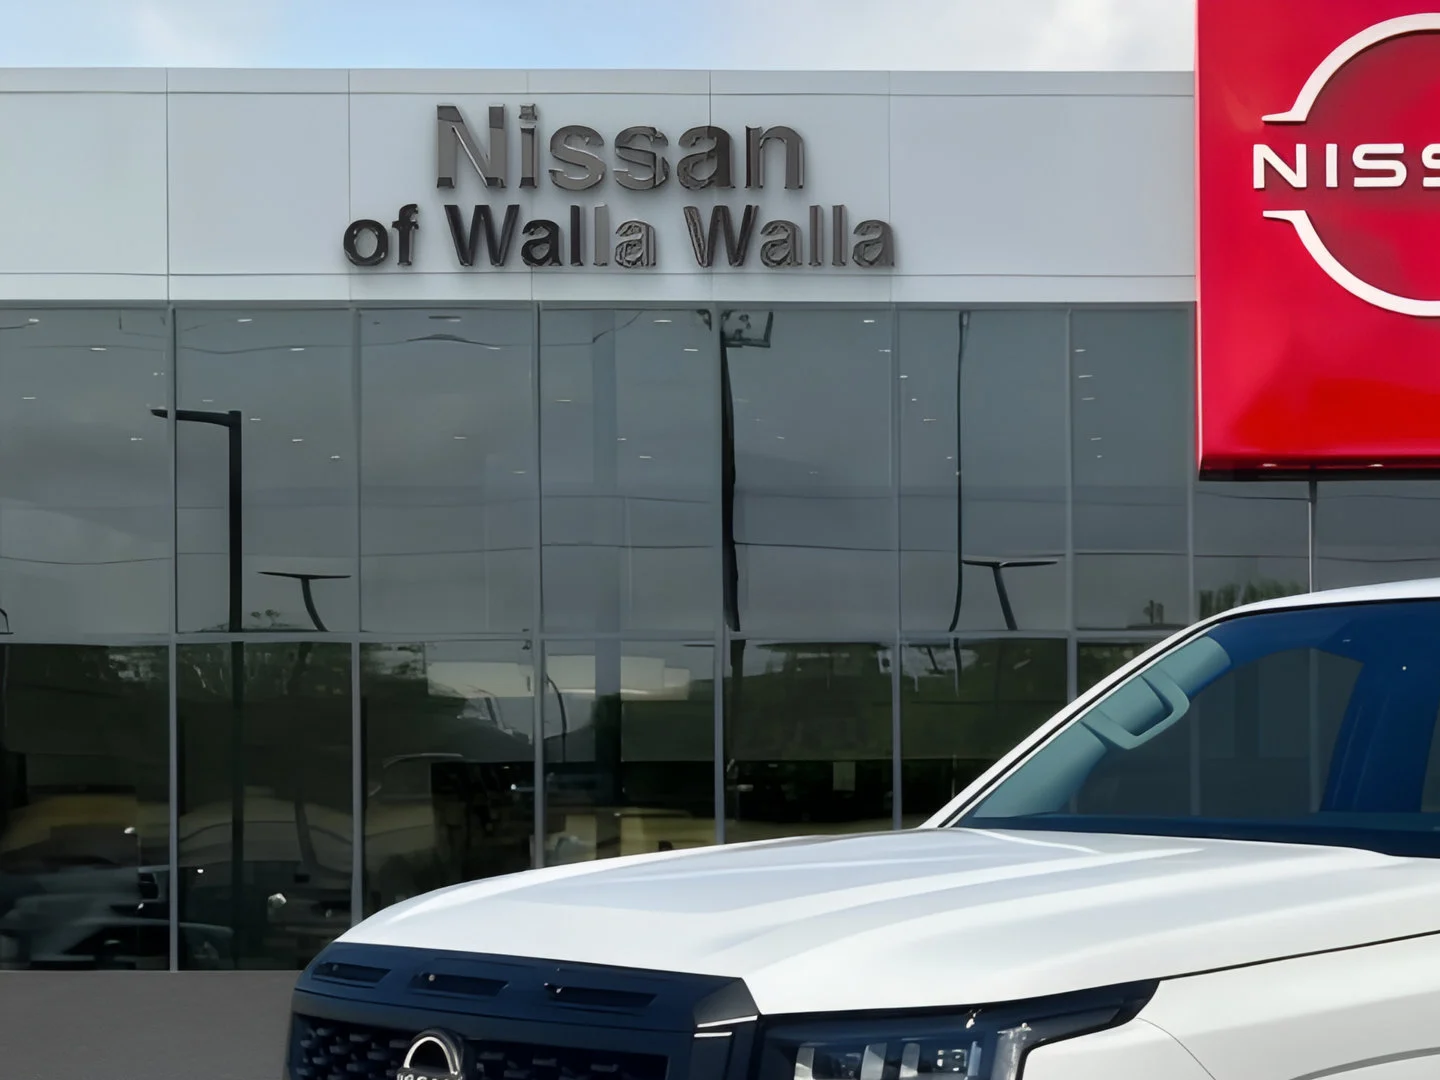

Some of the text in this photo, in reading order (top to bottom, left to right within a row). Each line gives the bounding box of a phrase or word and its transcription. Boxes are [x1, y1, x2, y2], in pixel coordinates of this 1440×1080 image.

[436, 103, 804, 190] Nissan
[343, 203, 895, 268] of Walla Walla
